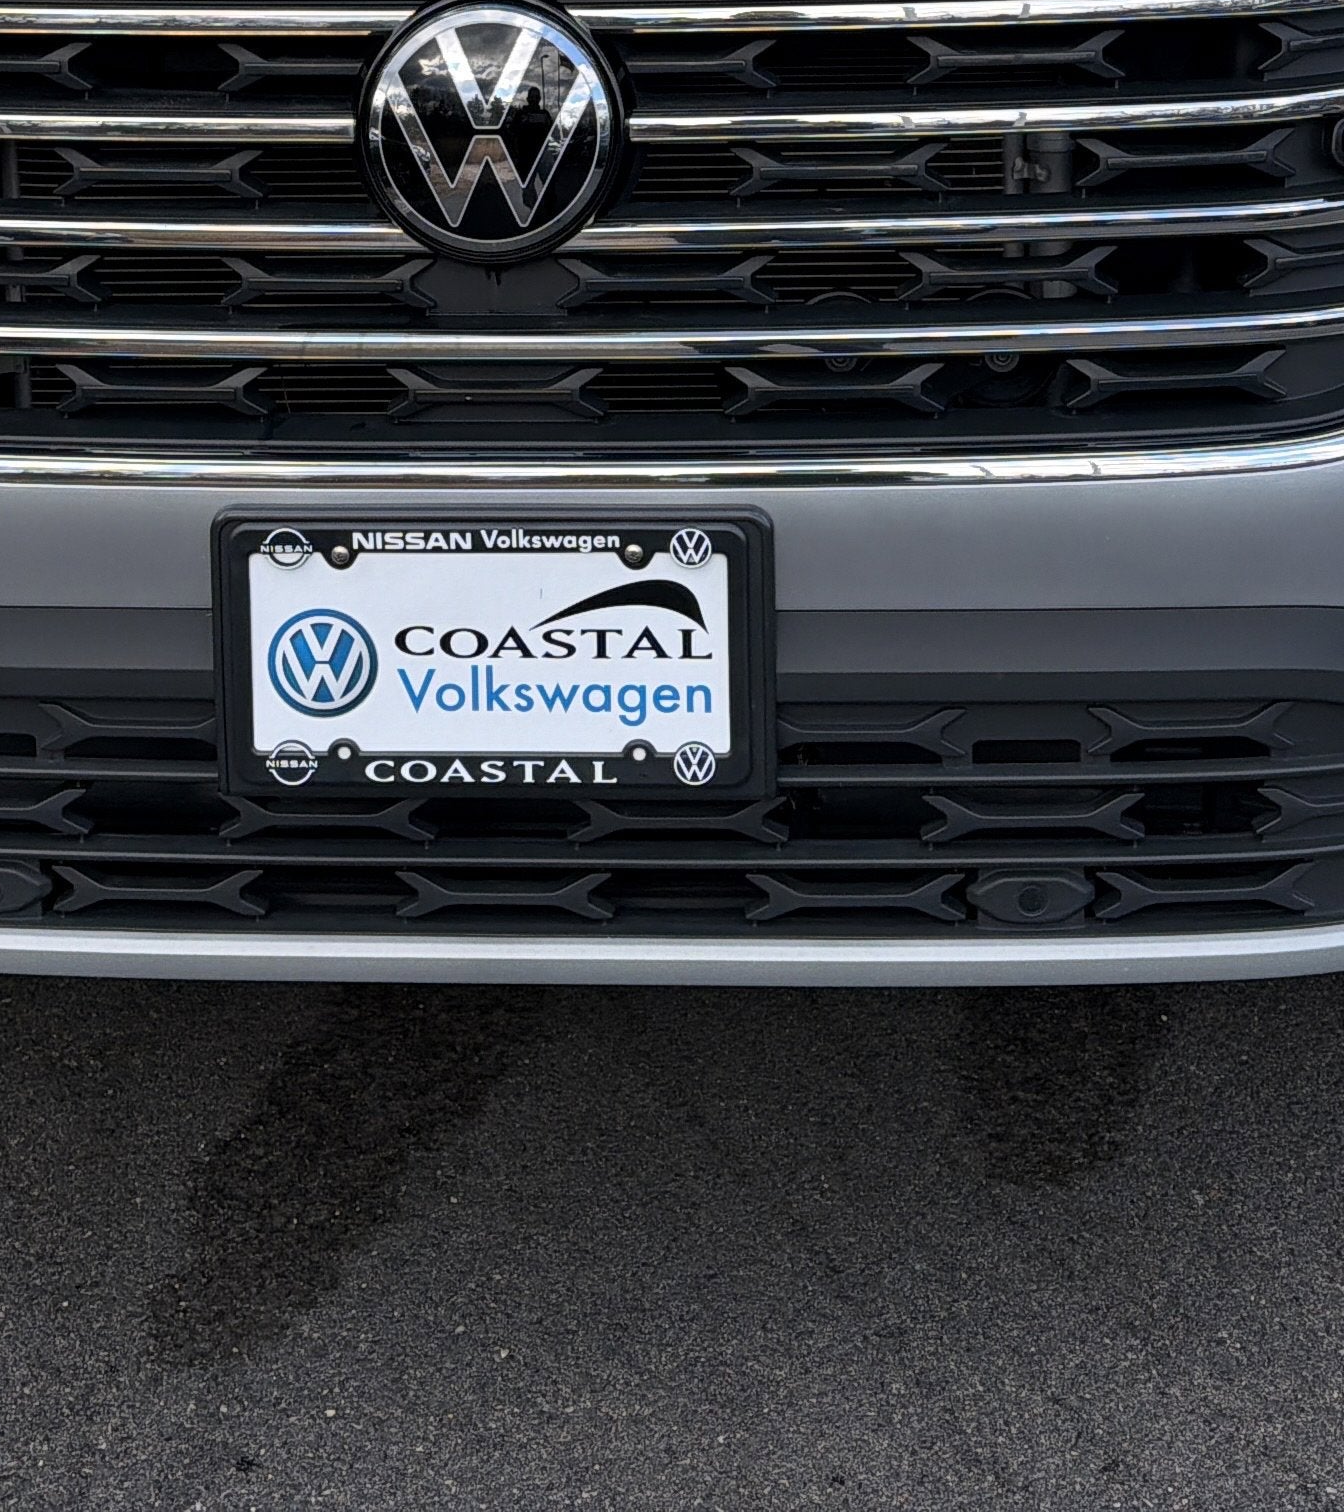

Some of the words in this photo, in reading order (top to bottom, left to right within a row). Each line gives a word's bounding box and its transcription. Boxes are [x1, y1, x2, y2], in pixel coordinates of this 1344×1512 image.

[260, 545, 313, 553] NISSAN
[352, 532, 472, 550] NISSAN
[480, 529, 620, 553] Volkswagen
[394, 625, 714, 660] COASTAL
[397, 664, 713, 726] Volkswagen
[265, 759, 318, 769] NISSAN
[364, 759, 618, 785] COASTAL
